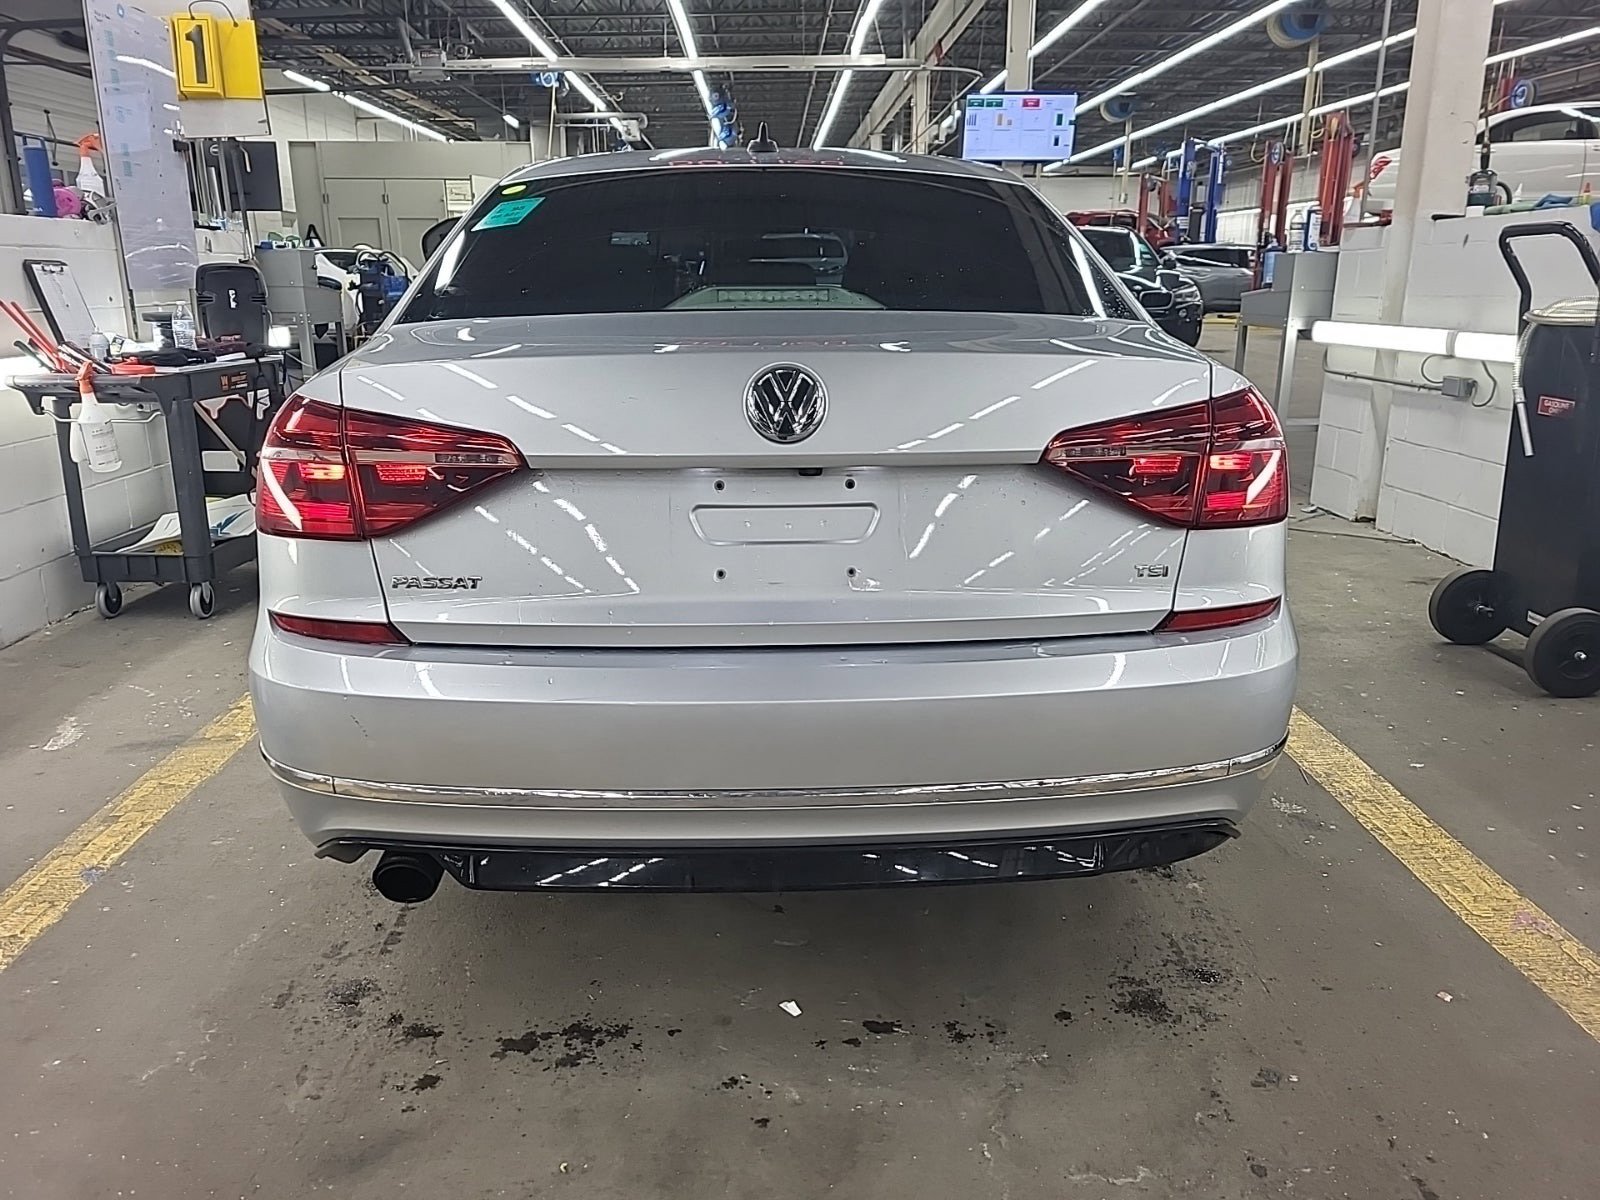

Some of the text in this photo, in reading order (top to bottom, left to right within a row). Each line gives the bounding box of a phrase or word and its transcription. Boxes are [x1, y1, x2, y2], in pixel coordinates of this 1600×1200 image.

[184, 24, 209, 84] 1
[1134, 564, 1169, 578] TSI
[391, 575, 483, 590] PASSAT
